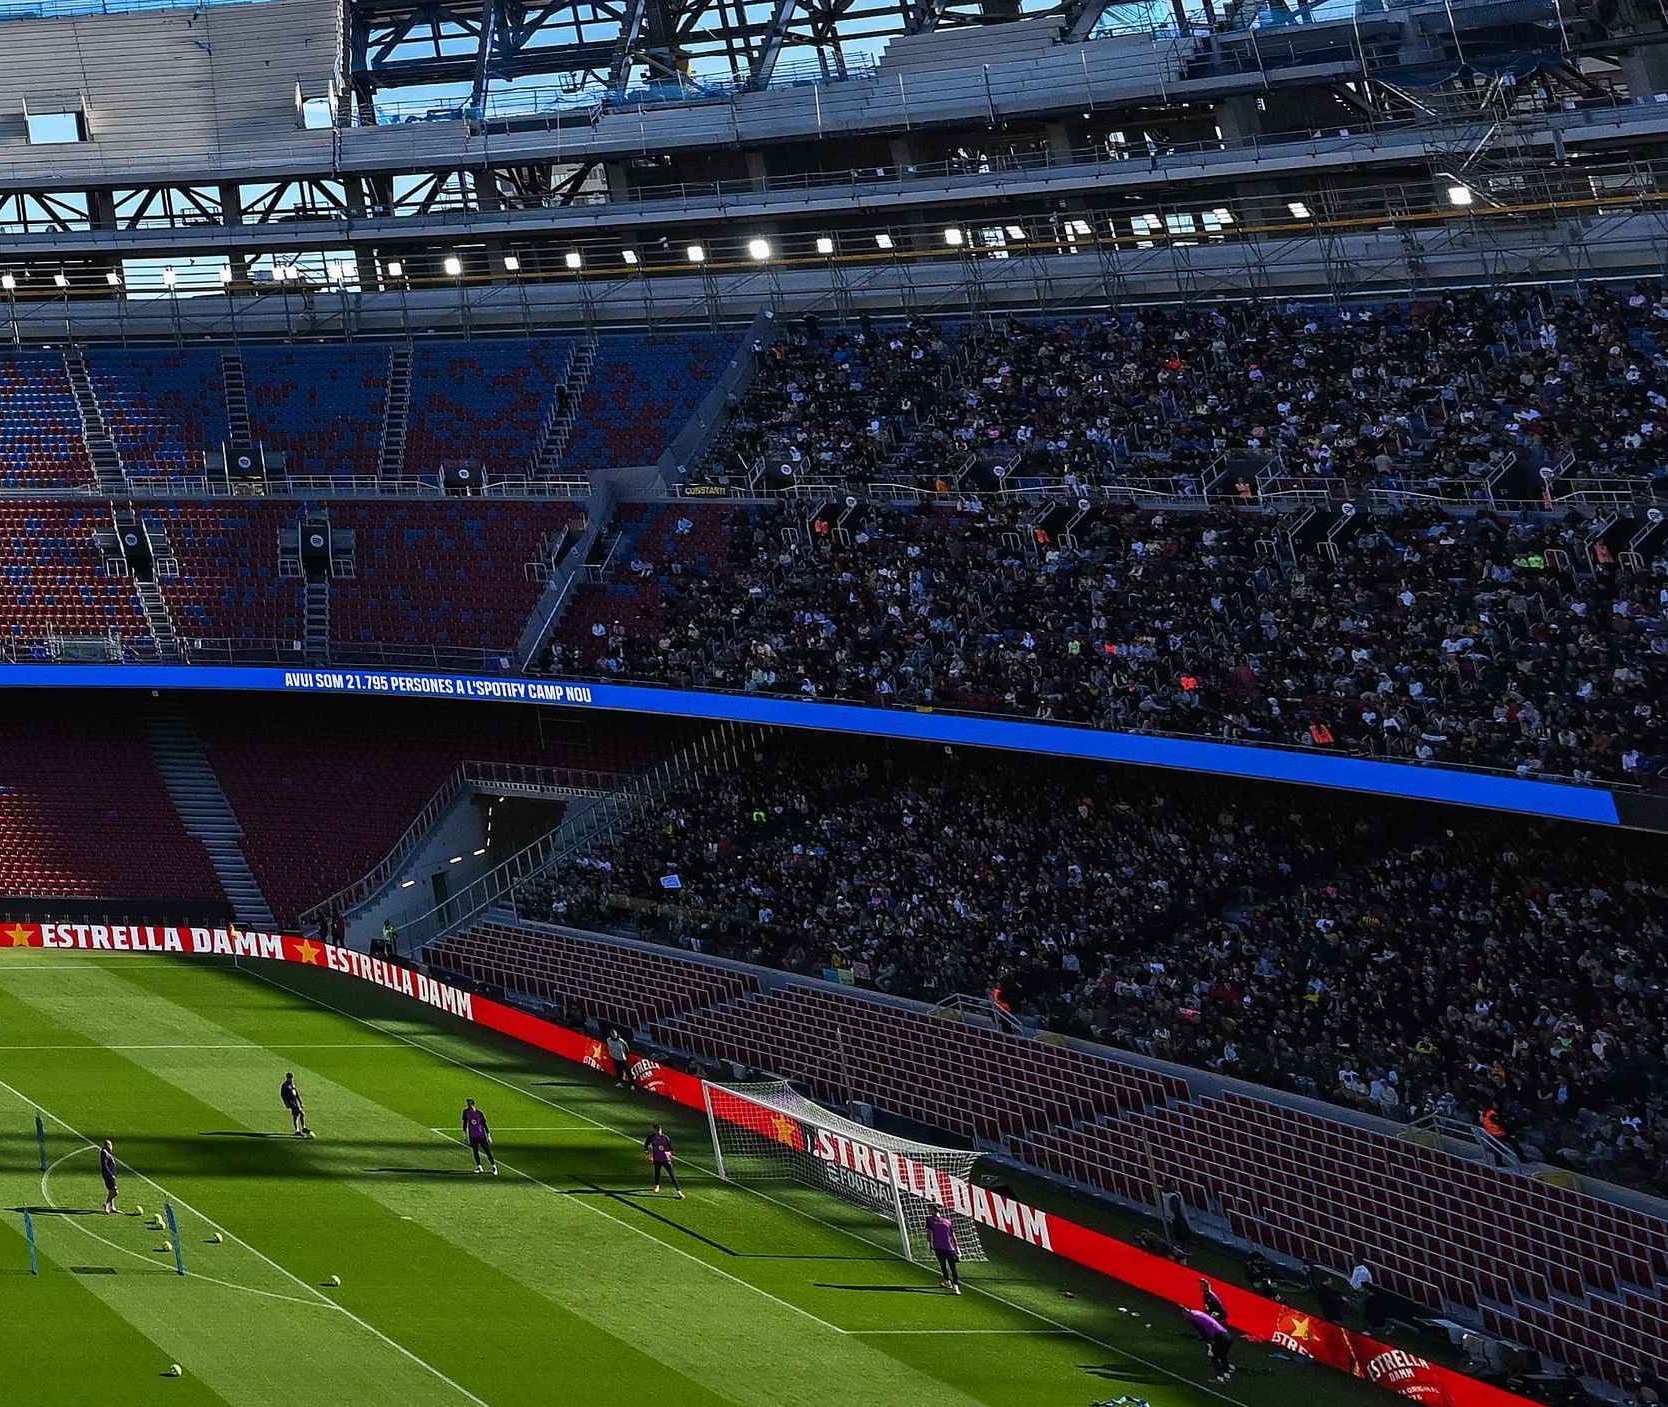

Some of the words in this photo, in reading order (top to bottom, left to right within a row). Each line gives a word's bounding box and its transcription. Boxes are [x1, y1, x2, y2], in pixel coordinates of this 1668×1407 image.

[285, 672, 313, 687] AVUI
[315, 674, 344, 688] SOM
[345, 675, 388, 690] 21.795
[390, 677, 453, 694] PERSONES
[456, 680, 465, 694] A
[467, 681, 525, 698] L'SPOTIFY
[528, 684, 563, 700] CAMP
[565, 686, 592, 703] NOU
[41, 923, 183, 953] ESTRELLA
[190, 927, 285, 960] DAMM
[324, 943, 413, 996] ESTRELLA
[417, 974, 474, 1021] DAMM
[948, 1174, 1054, 1252] DAMM
